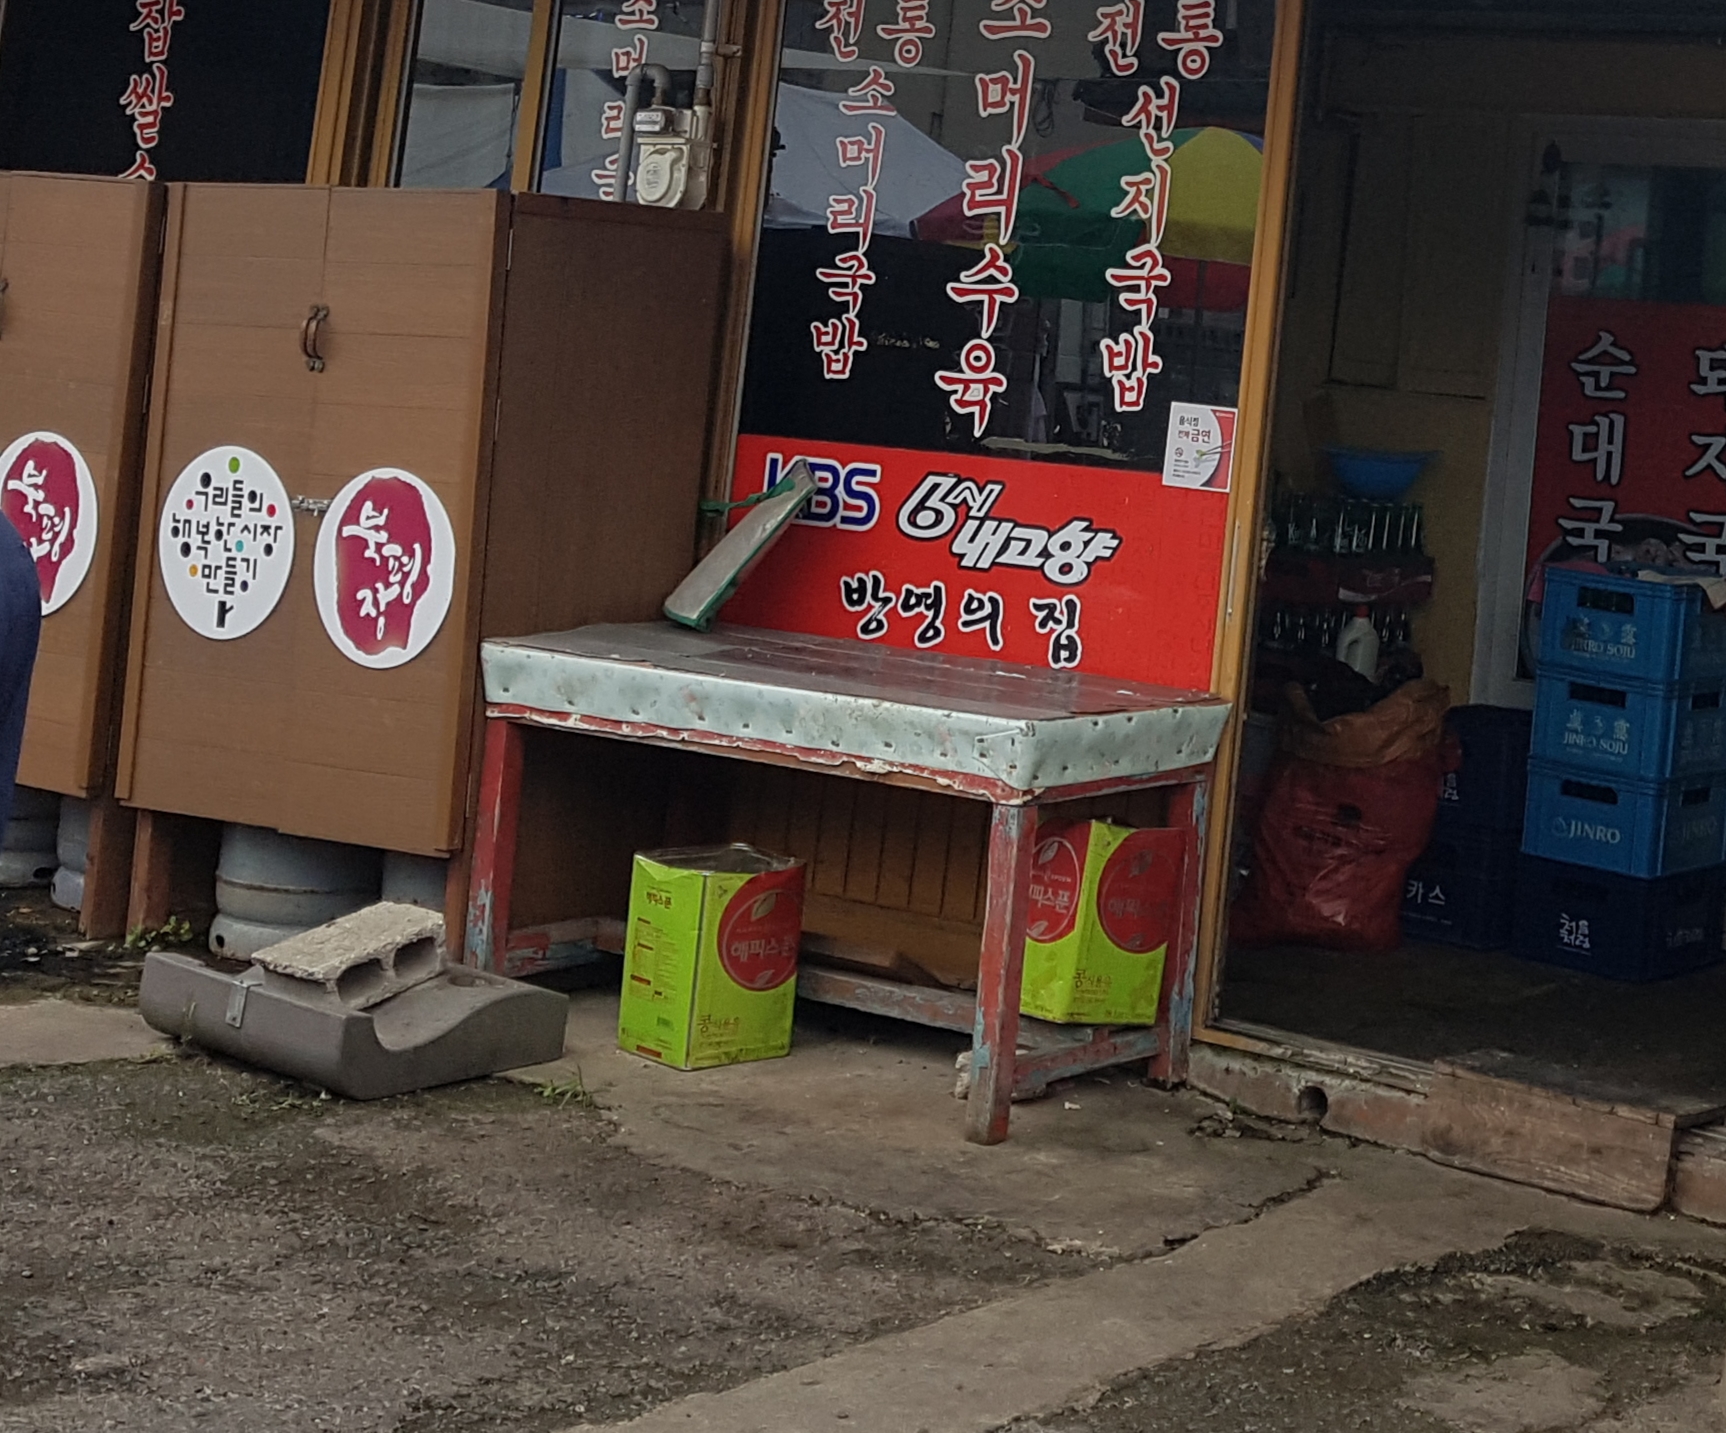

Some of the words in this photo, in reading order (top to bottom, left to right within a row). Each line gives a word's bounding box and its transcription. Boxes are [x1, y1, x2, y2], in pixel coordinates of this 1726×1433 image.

[810, 67, 897, 380] 소머리국밥
[1101, 76, 1180, 412] 선지국밥
[1191, 428, 1212, 444] 금연
[1556, 329, 1638, 564] 순대국
[195, 471, 264, 519] 우리들의
[240, 522, 283, 558] 시장
[950, 516, 1123, 586] 내고향
[201, 556, 258, 596] 만들기
[841, 569, 1004, 651] 방영의
[1030, 594, 1083, 670] 집
[1569, 819, 1622, 845] JINRO
[1028, 884, 1071, 914] 피스푼
[1405, 877, 1447, 906] 카스
